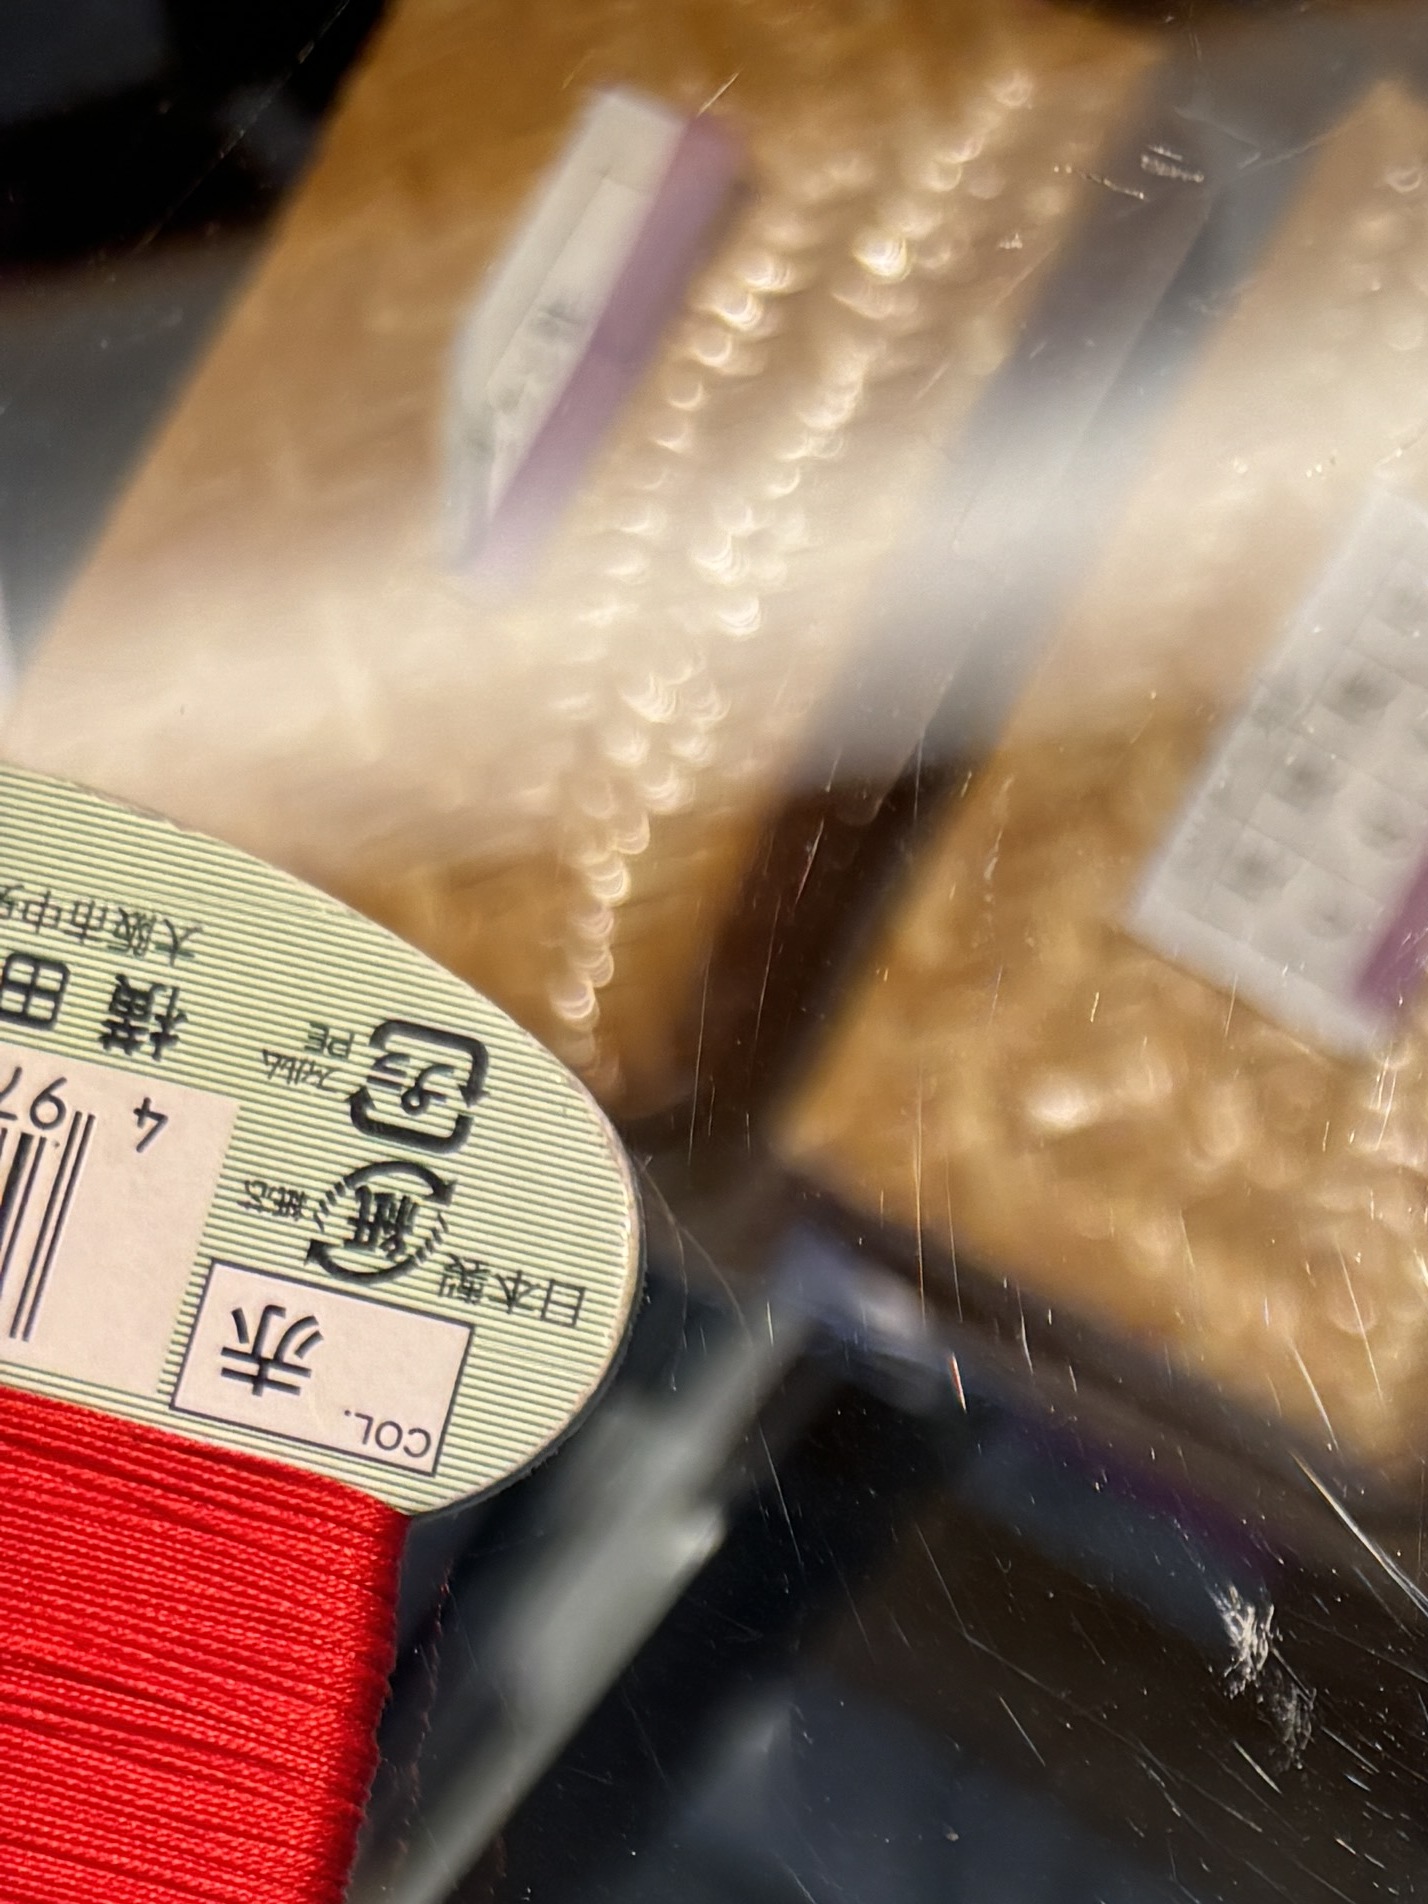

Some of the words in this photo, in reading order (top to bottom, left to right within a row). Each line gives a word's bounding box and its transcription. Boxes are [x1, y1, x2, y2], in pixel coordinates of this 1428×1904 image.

[304, 1021, 356, 1061] PE
[366, 1052, 455, 1117] プラ
[133, 1097, 169, 1153] 4
[343, 1184, 420, 1262] 紙
[438, 1253, 586, 1328] 日本製
[220, 1304, 325, 1397] 赤
[343, 1408, 432, 1458] COL.
